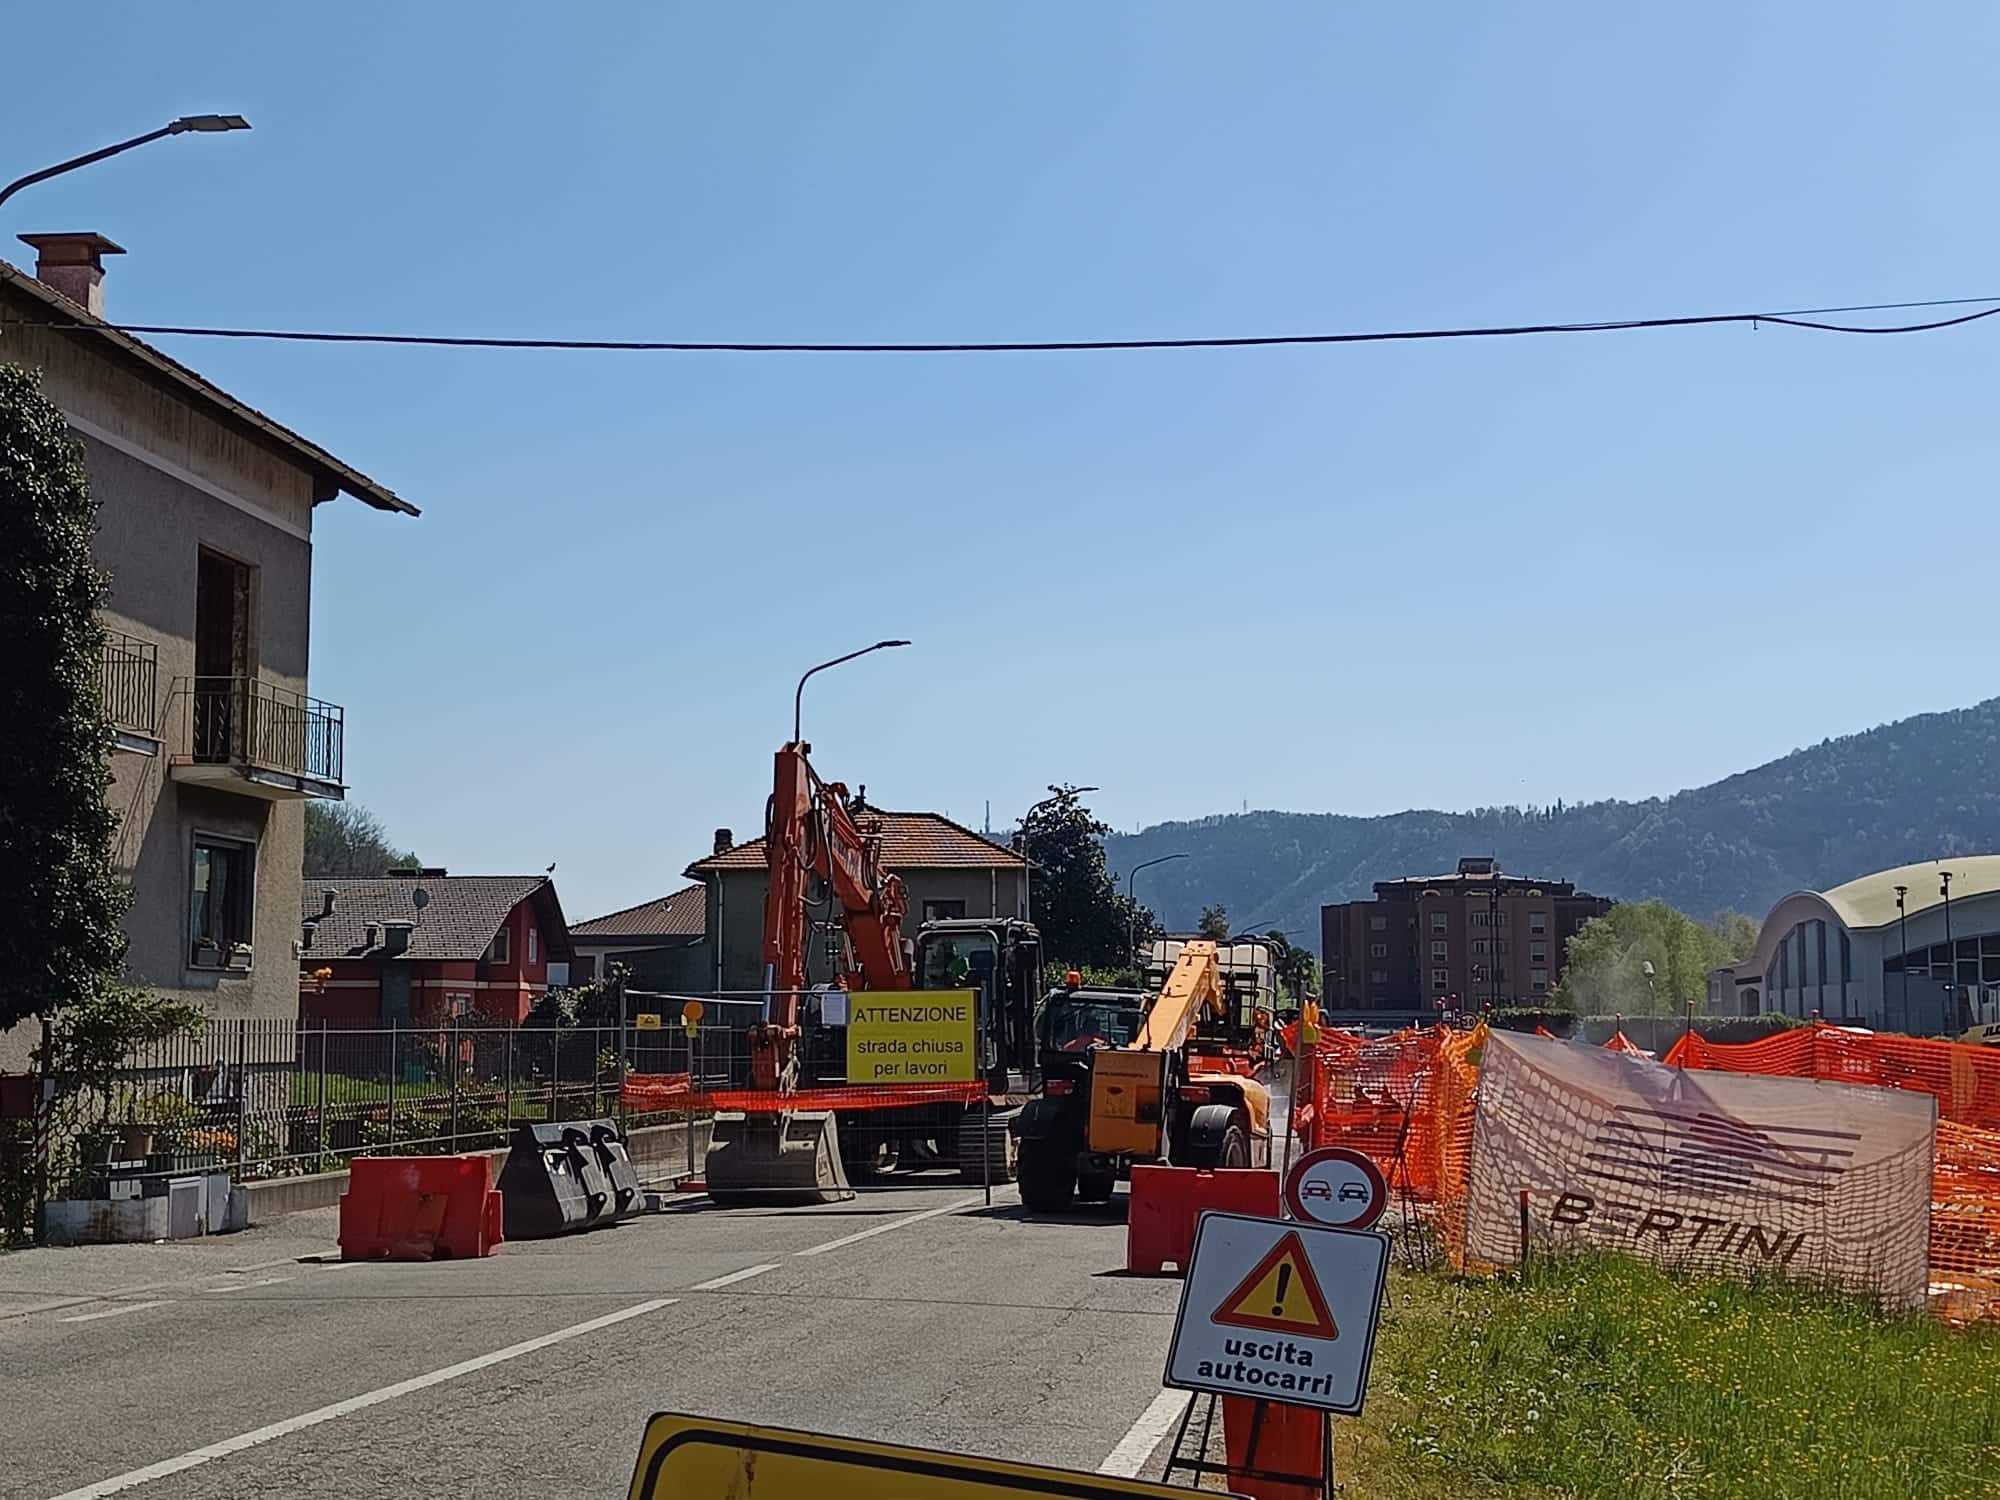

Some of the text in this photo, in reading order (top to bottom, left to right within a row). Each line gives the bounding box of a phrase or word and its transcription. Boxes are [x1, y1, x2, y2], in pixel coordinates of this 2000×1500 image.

[854, 1007, 967, 1023] ATTENZIONE
[857, 1039, 964, 1054] strada chiusa
[874, 1060, 948, 1078] per lavori
[1224, 1339, 1313, 1367] uscita
[1197, 1360, 1333, 1395] autocarri
